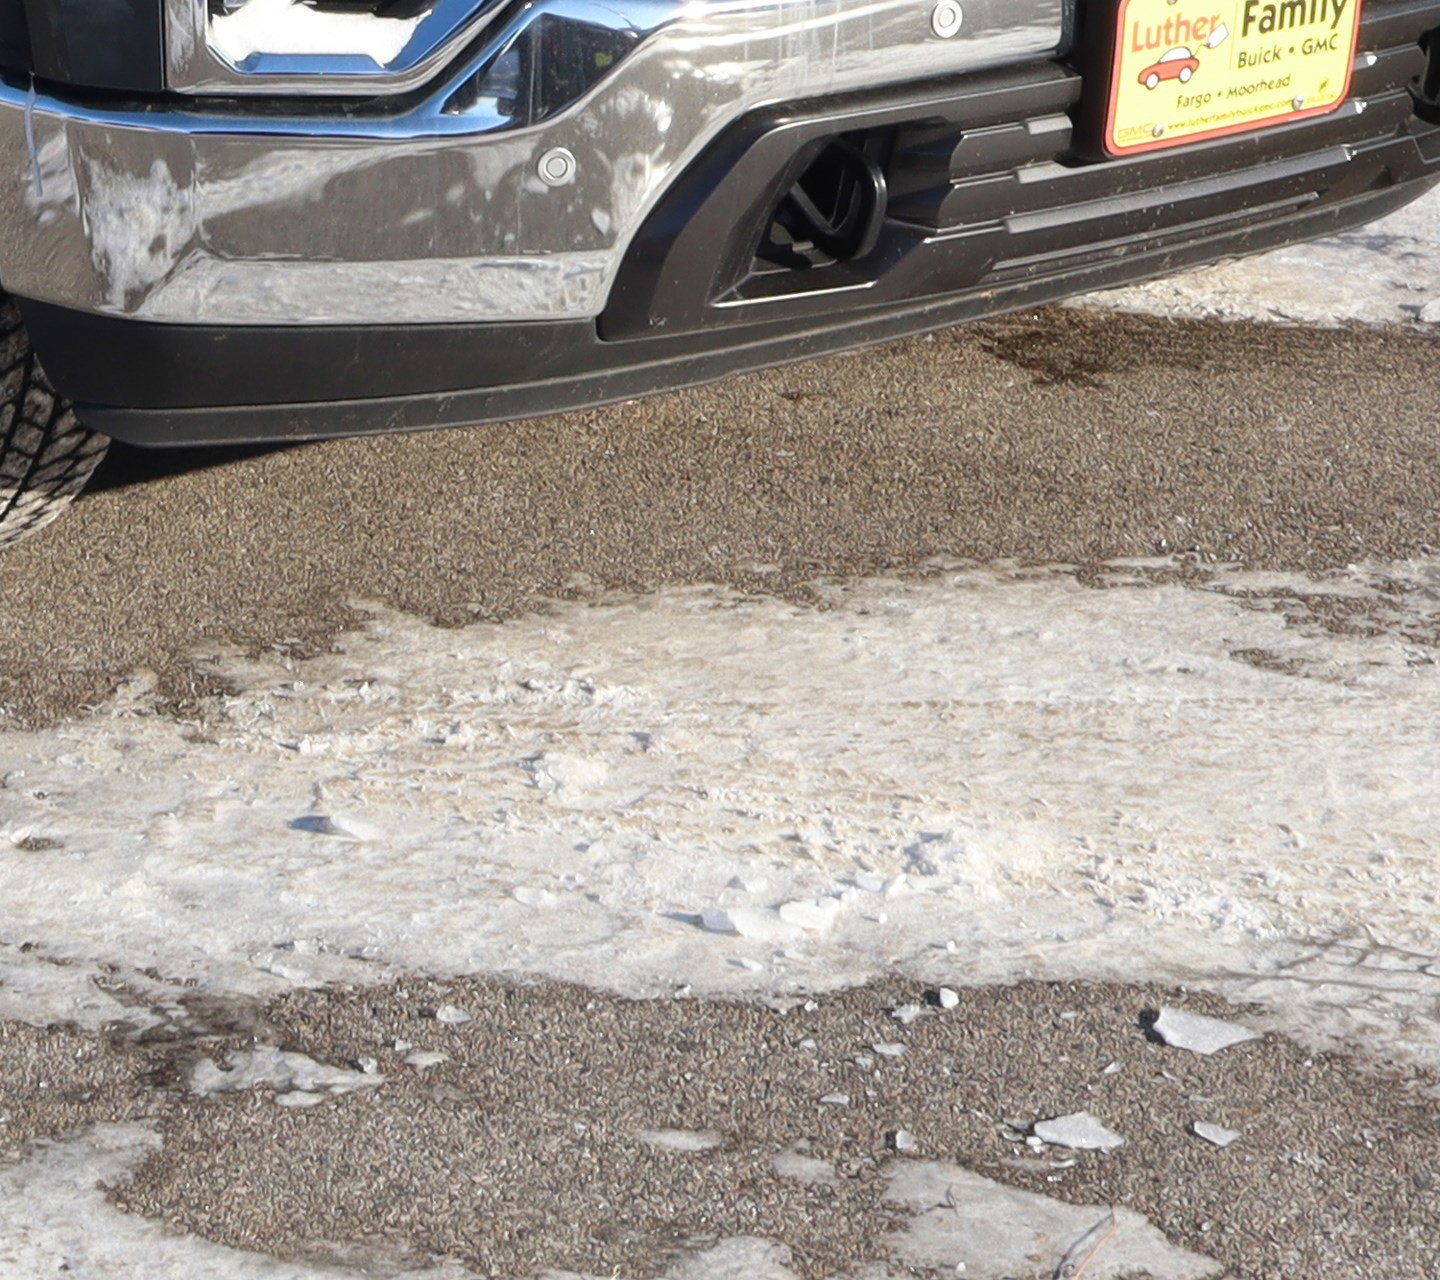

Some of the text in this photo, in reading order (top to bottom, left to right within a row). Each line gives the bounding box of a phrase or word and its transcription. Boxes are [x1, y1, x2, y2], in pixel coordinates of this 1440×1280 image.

[1130, 11, 1222, 53] Luther
[1236, 32, 1340, 70] Buick GMC
[1175, 91, 1213, 110] Fargo
[1225, 72, 1293, 99] Moorhead
